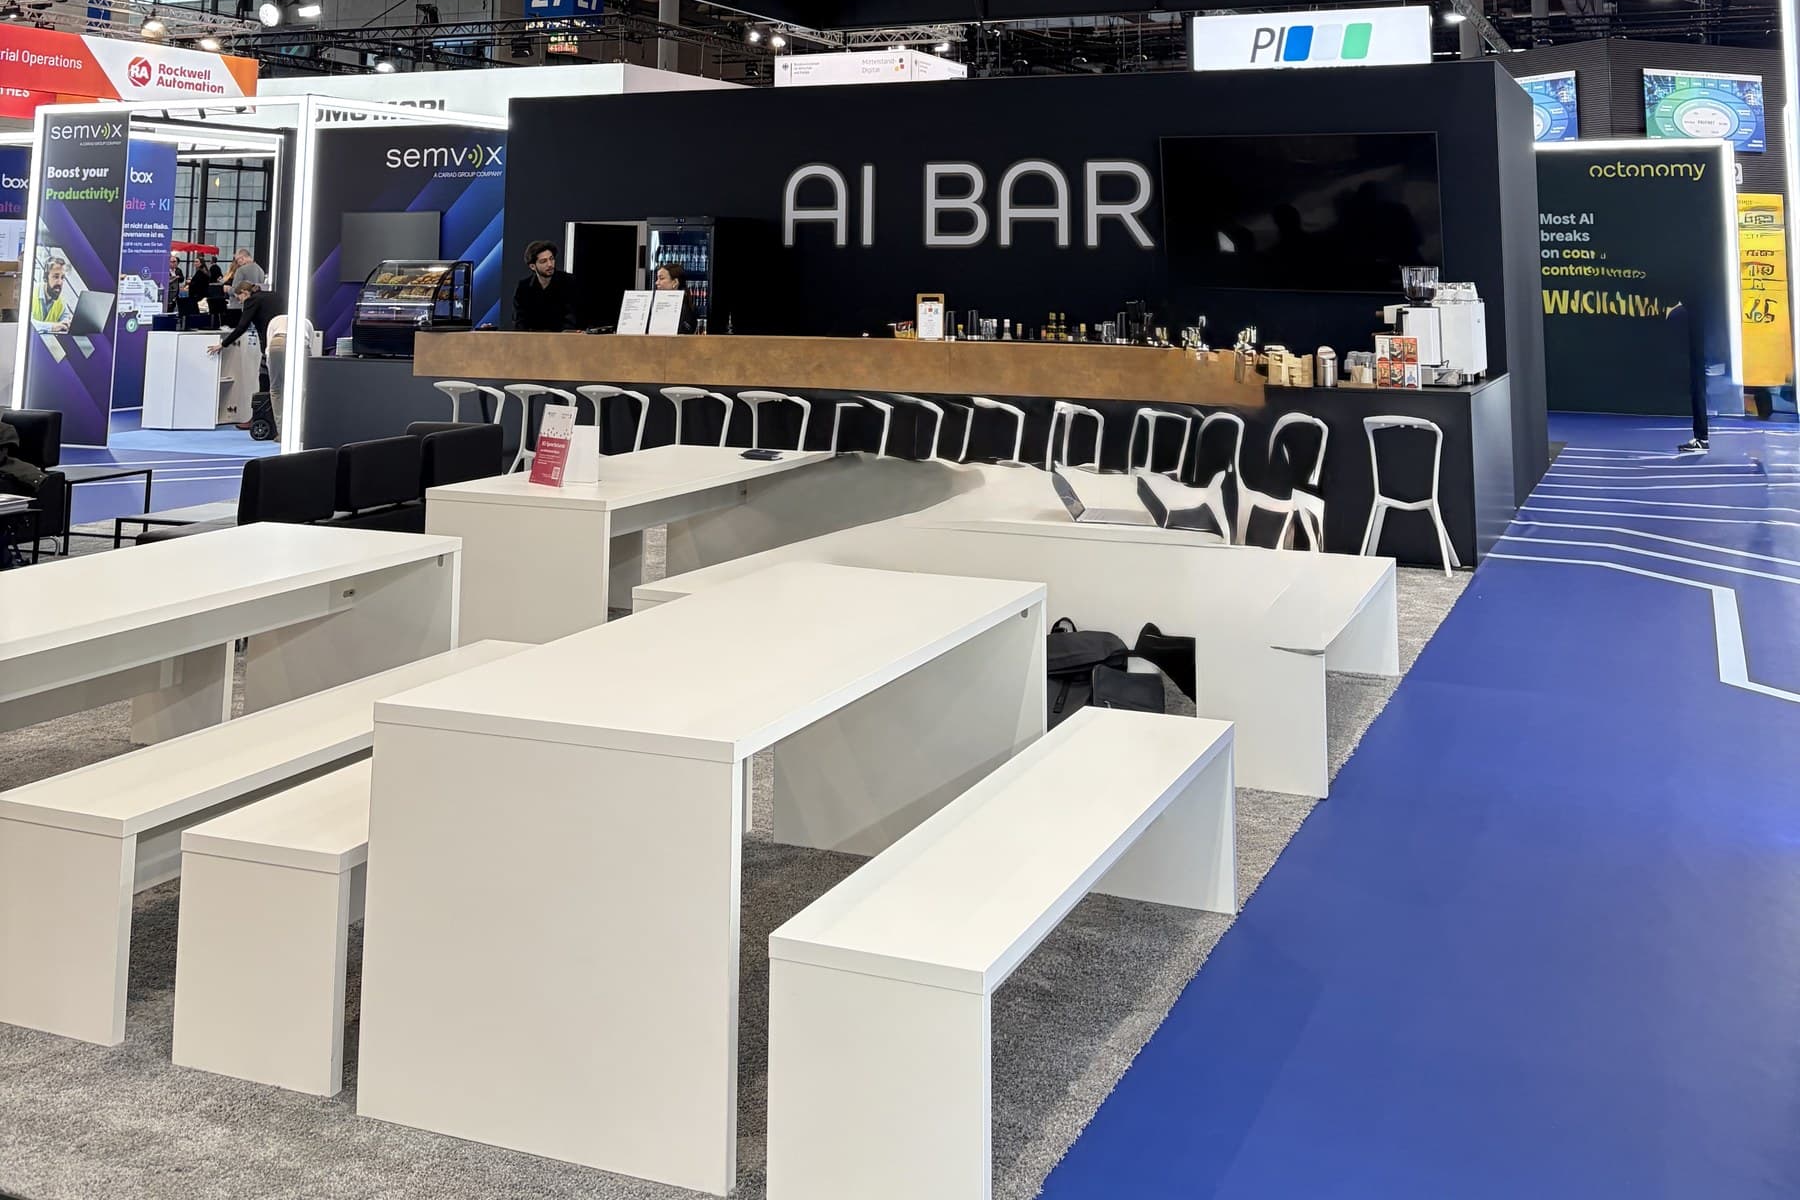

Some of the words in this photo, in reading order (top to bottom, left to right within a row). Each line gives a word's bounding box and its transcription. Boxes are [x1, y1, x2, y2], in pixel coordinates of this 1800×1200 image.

[0, 48, 19, 62] rial
[21, 49, 83, 69] Operations
[130, 65, 150, 80] RA
[158, 63, 211, 81] Rockwell
[156, 76, 225, 94] Automation
[47, 166, 80, 179] Boost
[82, 167, 109, 180] your
[130, 167, 153, 184] box
[1589, 161, 1706, 181] octonomy
[1, 174, 28, 189] box
[45, 187, 120, 202] Productivity!
[149, 200, 156, 208] +
[159, 198, 170, 211] KI
[784, 164, 874, 247] AI
[925, 160, 1155, 247] BAR
[1539, 213, 1576, 225] Most
[1579, 213, 1594, 225] AI
[1540, 230, 1590, 242] breaks
[1541, 249, 1560, 259] on
